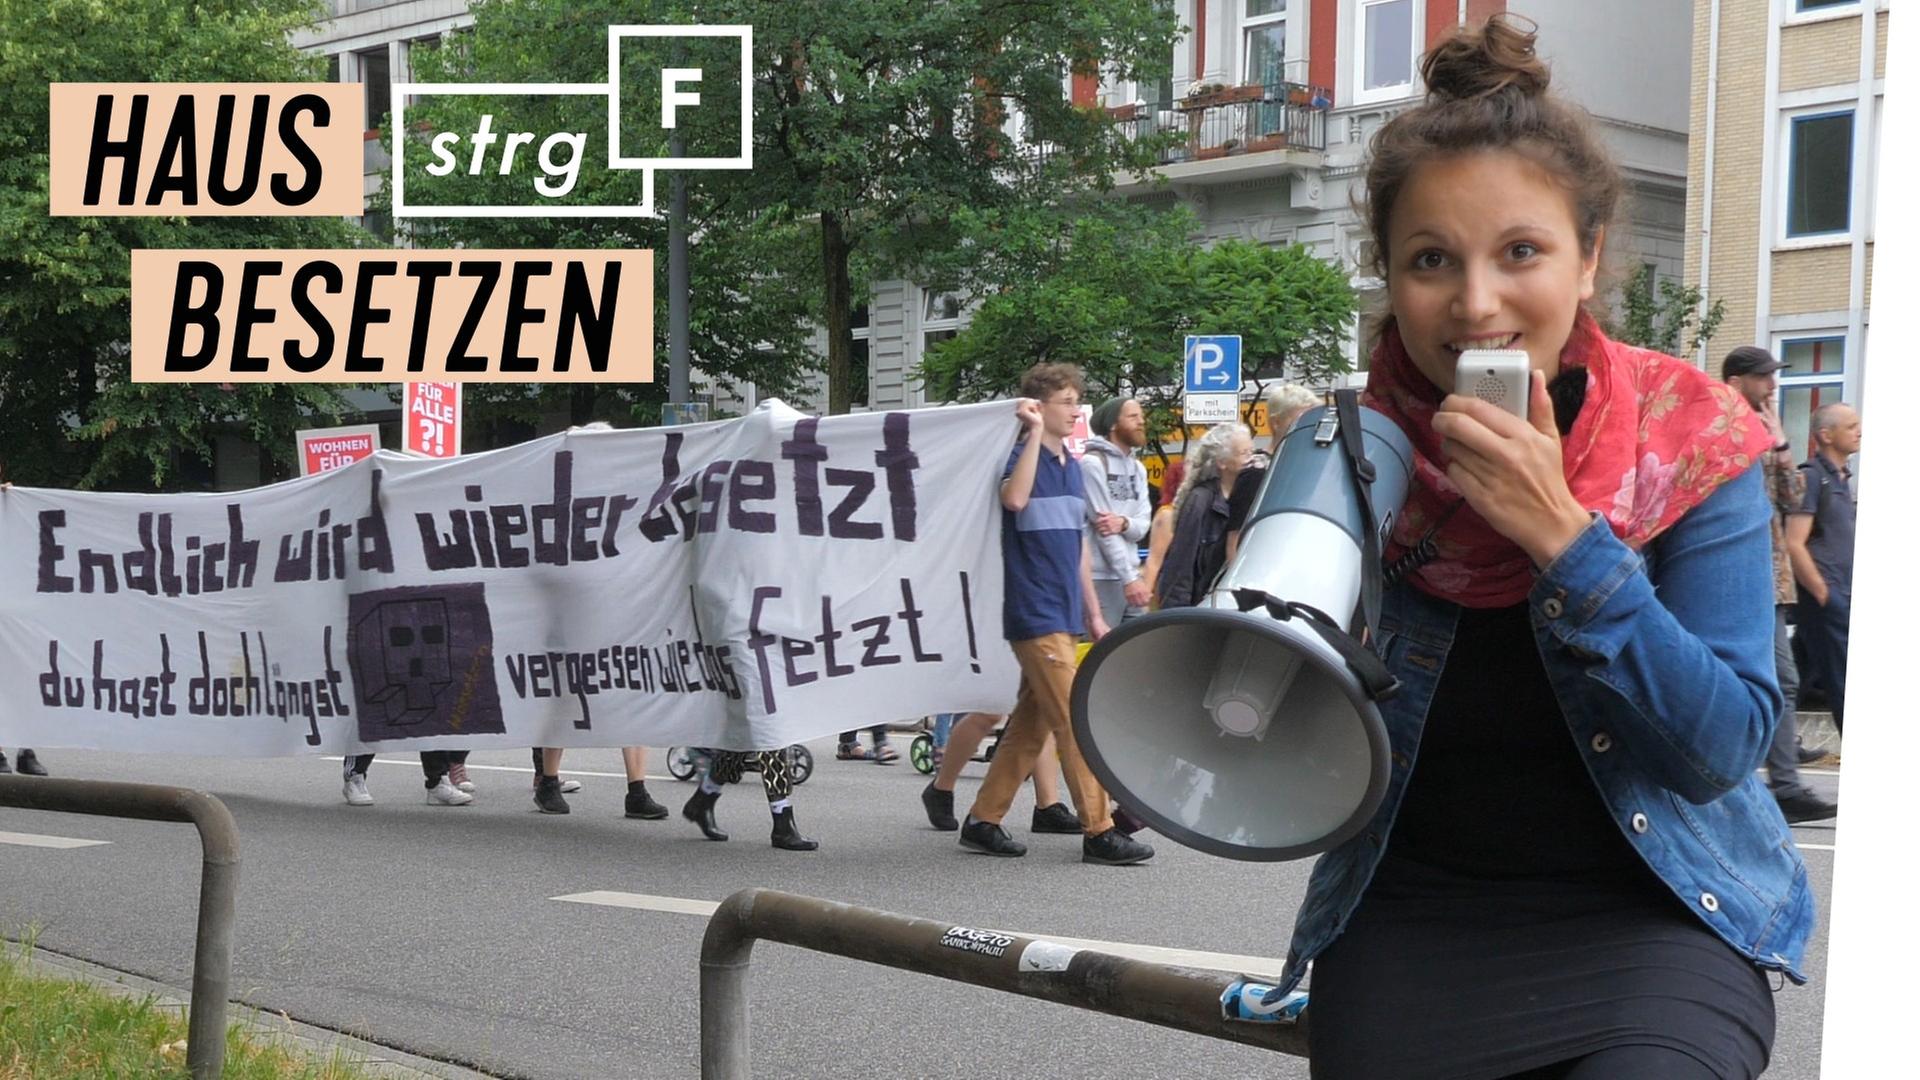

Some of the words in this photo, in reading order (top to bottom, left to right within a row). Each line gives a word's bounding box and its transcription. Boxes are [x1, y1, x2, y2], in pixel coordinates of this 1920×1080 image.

[1194, 343, 1224, 385] P
[418, 383, 443, 401] FÜR
[412, 398, 454, 424] ALLE
[1188, 408, 1235, 417] Parkschein
[309, 439, 369, 454] WOHNEN
[420, 419, 444, 456] ?!
[37, 504, 259, 597] Endlich
[274, 469, 394, 583] wird
[415, 451, 638, 568] wieder
[639, 413, 919, 542] besetzt
[39, 640, 84, 707] du
[93, 633, 177, 719] hast
[189, 631, 261, 717] doch
[506, 644, 655, 730] vergessen
[654, 628, 702, 694] wie
